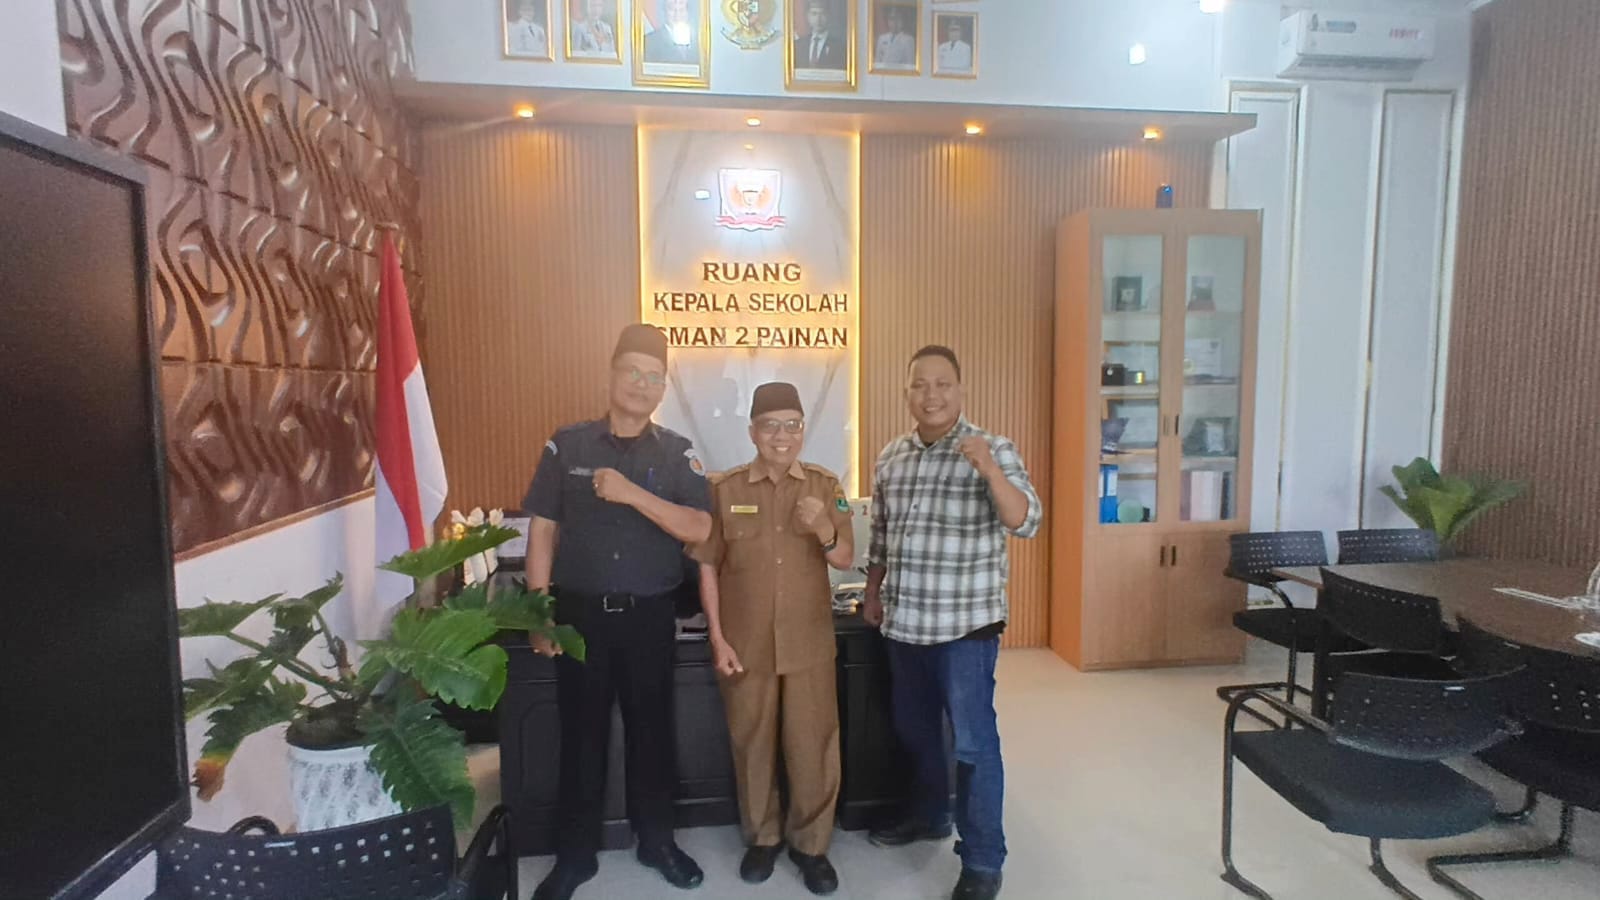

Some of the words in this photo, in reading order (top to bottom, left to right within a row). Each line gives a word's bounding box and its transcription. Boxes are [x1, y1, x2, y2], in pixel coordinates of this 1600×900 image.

[703, 262, 801, 281] RUANG
[653, 292, 740, 313] KEPALA
[749, 292, 848, 313] SEKOLAH
[656, 326, 726, 345] MAN
[735, 326, 749, 345] 2
[756, 327, 848, 346] PAINAN
